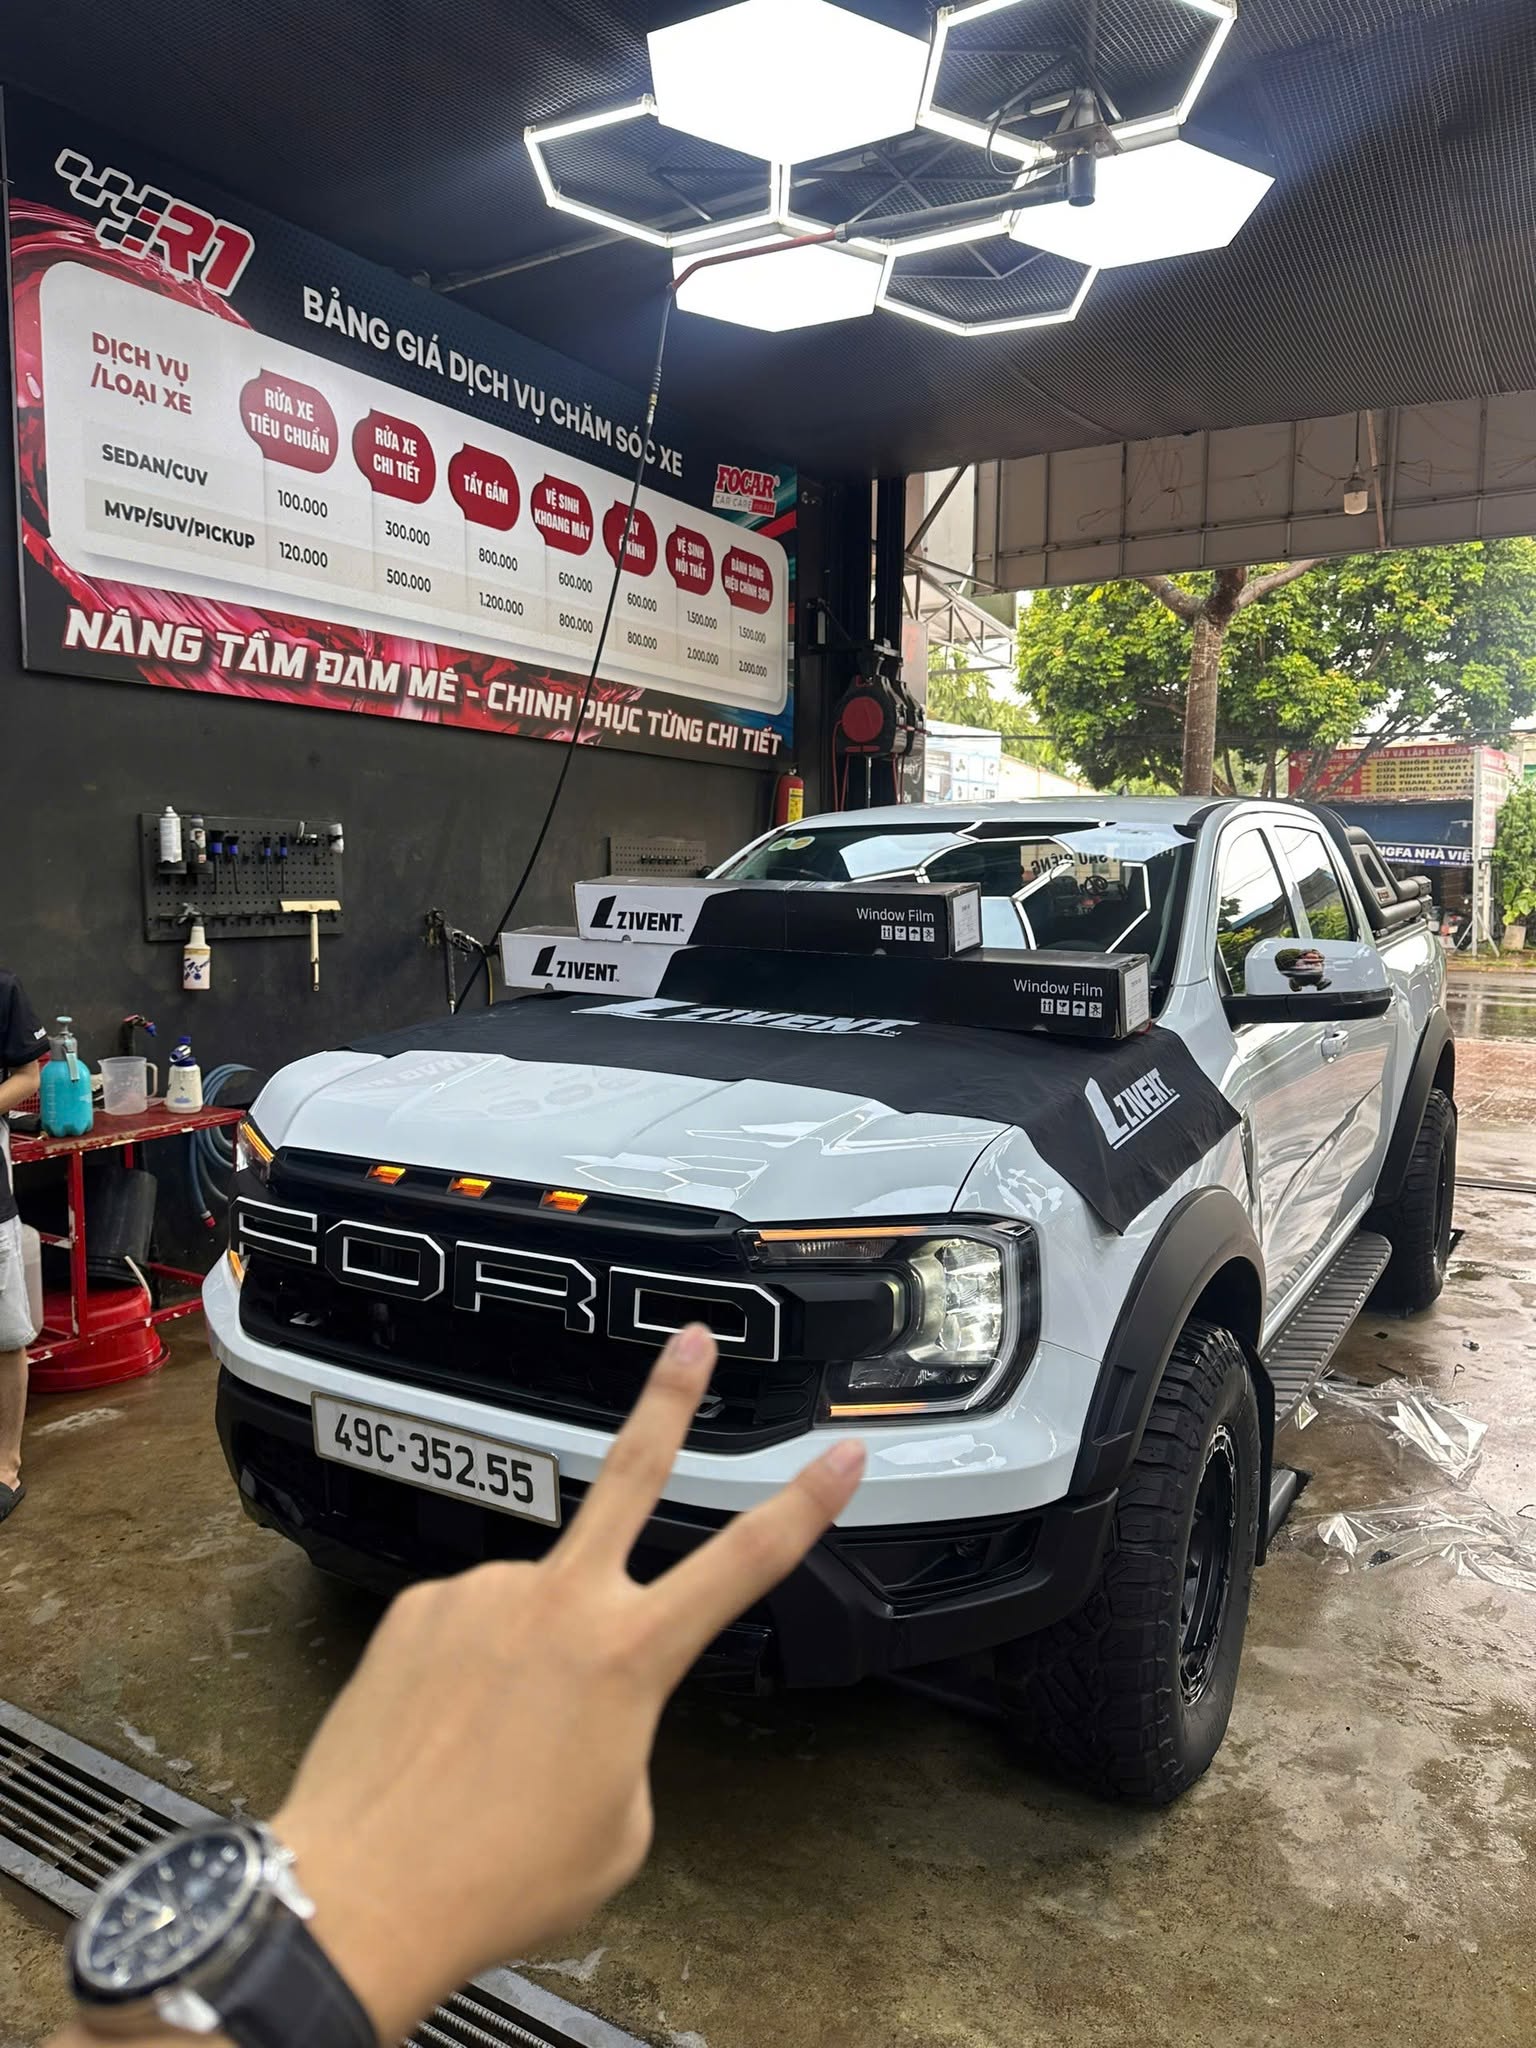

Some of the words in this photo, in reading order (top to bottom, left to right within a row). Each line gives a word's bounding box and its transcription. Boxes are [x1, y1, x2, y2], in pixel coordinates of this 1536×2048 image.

[92, 332, 150, 370] DỊCH
[157, 354, 189, 387] VỤ
[91, 362, 156, 406] /LOẠI
[163, 387, 192, 415] XE
[304, 286, 390, 350] BẢNG
[396, 329, 444, 375] GIÁ
[450, 350, 508, 401] DỊCH
[514, 378, 545, 424] VỤ
[551, 397, 612, 446] CHĂM
[615, 425, 656, 464] SÓC
[659, 445, 683, 477] XE
[264, 386, 294, 415] RỬA
[297, 400, 314, 422] XE
[248, 411, 280, 439] TIÊU
[284, 424, 330, 456] CHUẨN
[375, 426, 400, 451] RỬA
[402, 436, 417, 457] XE
[102, 443, 208, 486] SEDAN/CUV
[373, 454, 394, 476] CHI
[396, 459, 420, 484] TIẾT
[463, 471, 483, 497] TẨY
[278, 490, 327, 518] 100.000
[545, 487, 557, 510] VỆ
[558, 493, 580, 515] SINH
[104, 499, 255, 549] MVP/SUV/PICKUP
[385, 520, 430, 546] 300.000
[534, 507, 570, 534] KHOANG
[571, 521, 590, 541] MÁY
[279, 541, 328, 567] 120.000
[479, 547, 518, 571] 800.000
[626, 539, 646, 560] KÍNH
[677, 537, 687, 555] VỆ
[688, 541, 705, 560] SINH
[386, 568, 431, 592] 500.000
[675, 557, 688, 577] NỘI
[559, 572, 592, 593] 600.000
[479, 592, 523, 616] 1.200.000
[627, 592, 657, 612] 600.000
[559, 613, 593, 633] 800.000
[687, 610, 717, 630] 1.500.000
[627, 631, 658, 650] 800.000
[687, 647, 719, 666] 2.000.000
[738, 660, 767, 677] 2.000.000
[65, 607, 203, 664] NÂNG
[216, 627, 308, 679] TẦM
[316, 650, 400, 694] ĐAM
[407, 666, 459, 703] MÊ
[487, 681, 573, 722] CHINH
[580, 698, 643, 734] PHỤC
[647, 709, 703, 743] TỪNG
[706, 723, 739, 749] CHI
[741, 726, 782, 755] TIẾT
[1376, 846, 1412, 858] NGFA
[1414, 847, 1445, 860] NHÀ
[1448, 848, 1473, 864] VIỆ
[856, 907, 905, 922] Window
[908, 909, 935, 923] Film
[1013, 978, 1070, 996] Window
[1073, 981, 1103, 997] Film
[229, 1196, 781, 1362] FORD
[335, 1413, 534, 1504] 49C-352.55
